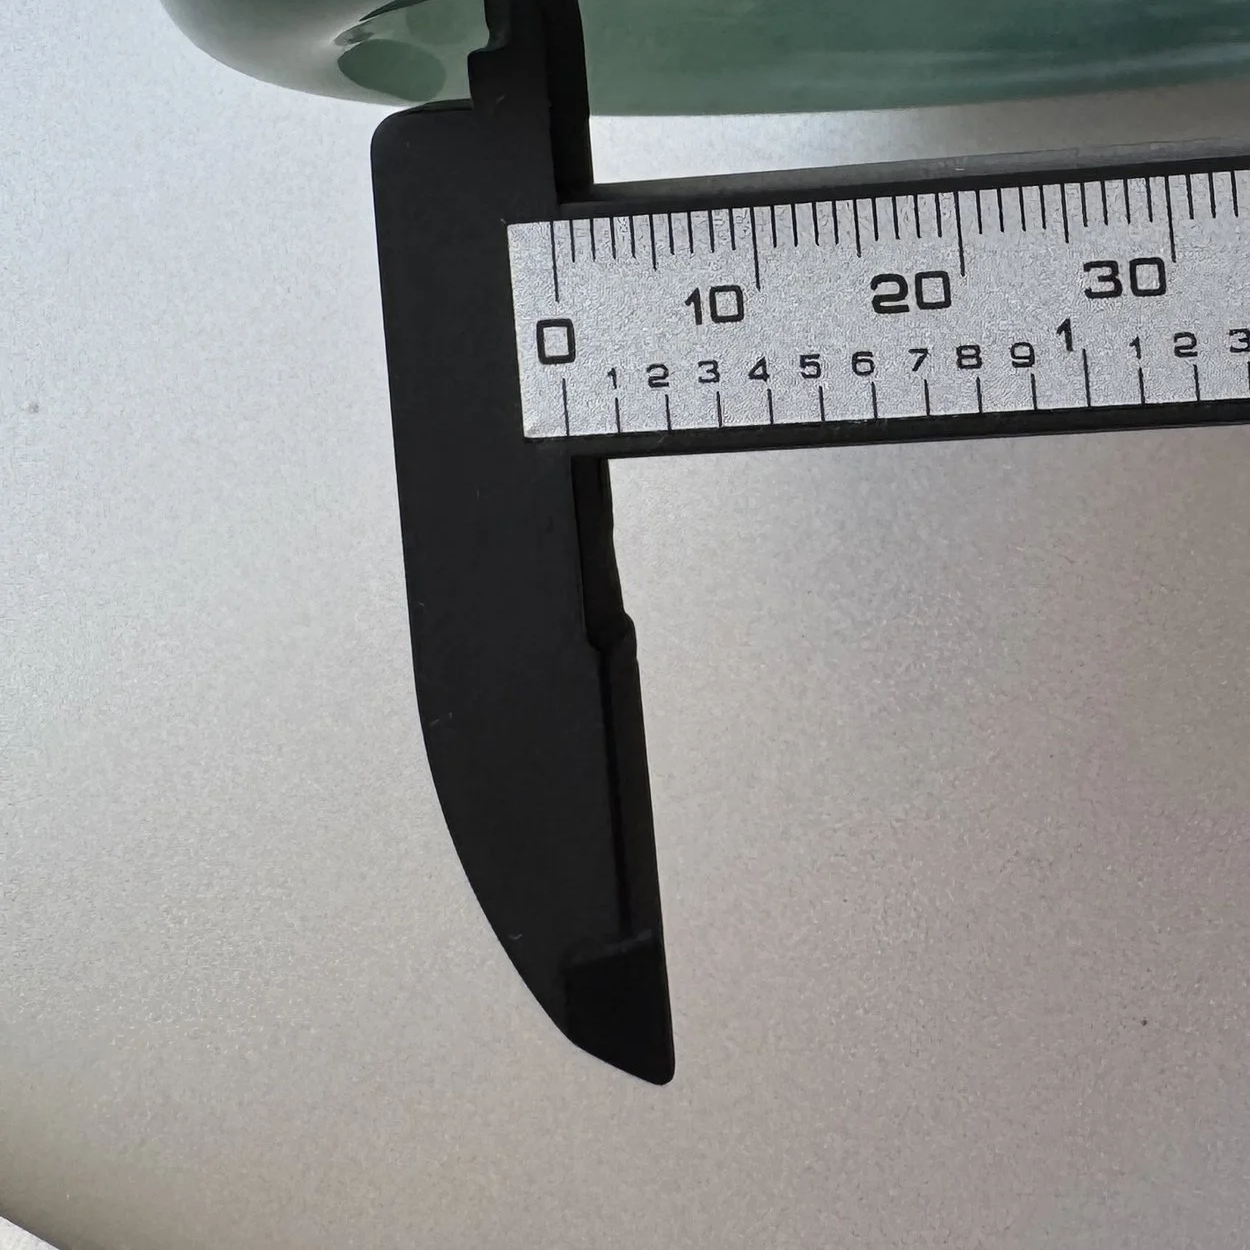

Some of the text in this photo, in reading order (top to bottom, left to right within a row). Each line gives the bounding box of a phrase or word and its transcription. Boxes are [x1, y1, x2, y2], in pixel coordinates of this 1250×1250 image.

[536, 318, 576, 366] 0
[684, 284, 745, 326] 10
[870, 270, 952, 315] 20
[1083, 256, 1167, 300] 30
[607, 367, 618, 389] 1
[646, 363, 670, 389] 2
[697, 359, 721, 384] 3
[748, 357, 770, 383] 4
[799, 353, 822, 380] 5
[851, 350, 875, 377] 6
[908, 347, 929, 372] 7
[955, 344, 983, 370] 8
[1009, 341, 1036, 369] 9
[1056, 318, 1074, 353] 1
[1129, 336, 1142, 360] 1
[1173, 331, 1198, 358] 2
